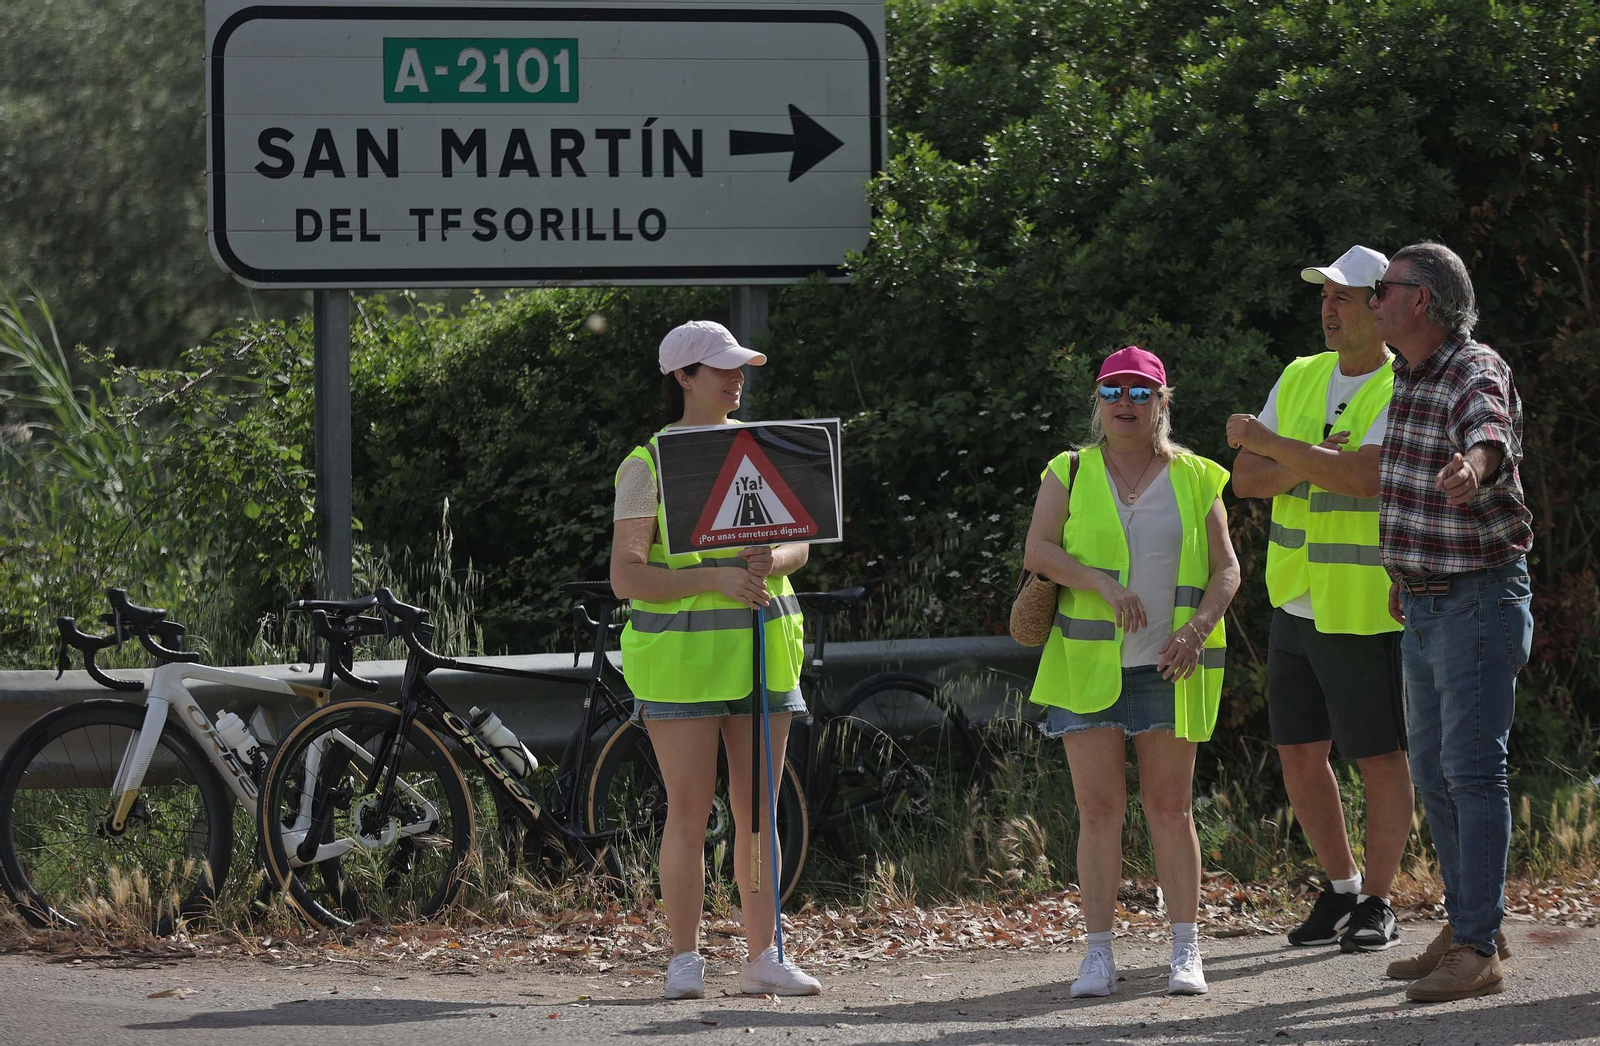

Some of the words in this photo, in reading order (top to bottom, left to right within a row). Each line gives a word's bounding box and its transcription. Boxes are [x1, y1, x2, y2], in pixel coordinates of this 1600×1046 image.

[394, 47, 570, 93] A-2101
[254, 127, 399, 179] SAN
[441, 117, 703, 178] MARTÍN
[295, 208, 381, 243] DEL
[735, 475, 763, 496] ¡Ya!
[699, 534, 715, 545] ¡Por
[717, 533, 736, 541] unas
[738, 529, 778, 539] carreteras
[780, 525, 809, 537] dignas!
[187, 705, 258, 801] ORBE
[443, 711, 541, 820] ORBEA
